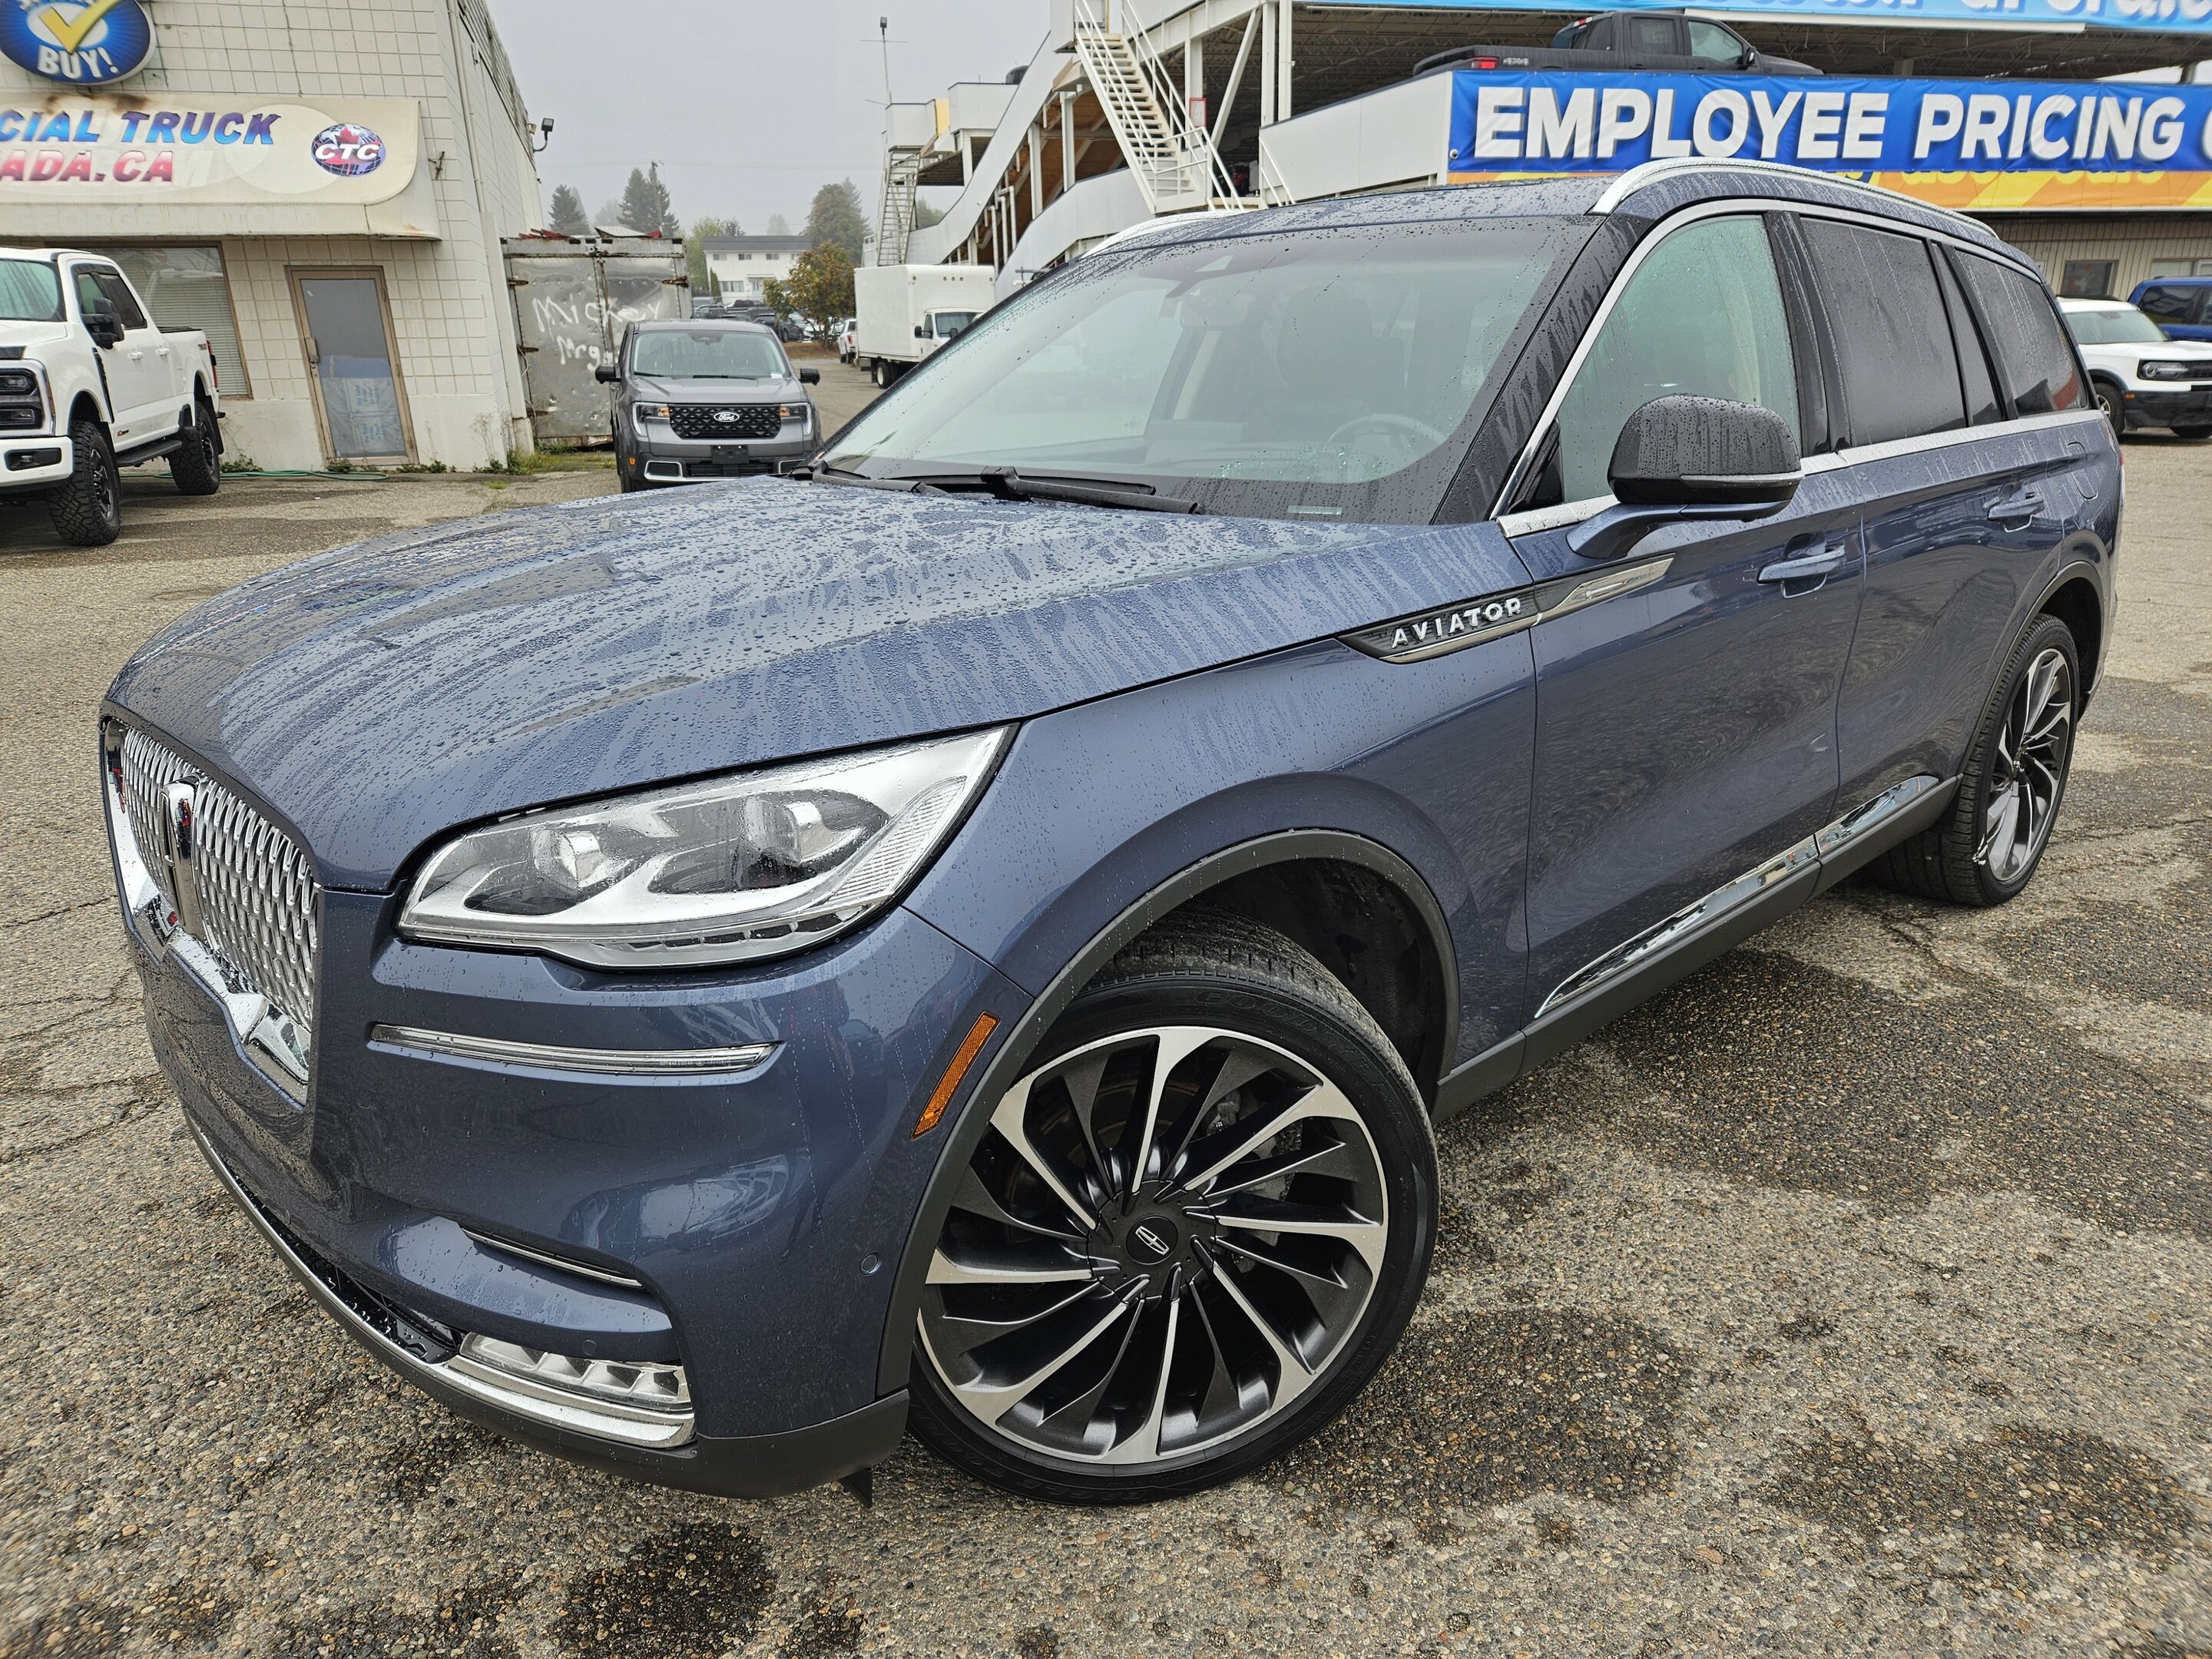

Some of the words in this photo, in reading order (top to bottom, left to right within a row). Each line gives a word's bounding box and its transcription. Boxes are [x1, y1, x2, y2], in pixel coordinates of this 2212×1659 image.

[37, 45, 119, 79] BUY!
[121, 111, 281, 144] TRUCK
[1474, 86, 1889, 159] EMPLOYEE
[1913, 93, 2186, 162] PRICING
[315, 143, 380, 161] CTC
[1391, 597, 1522, 649] AVIATOR
